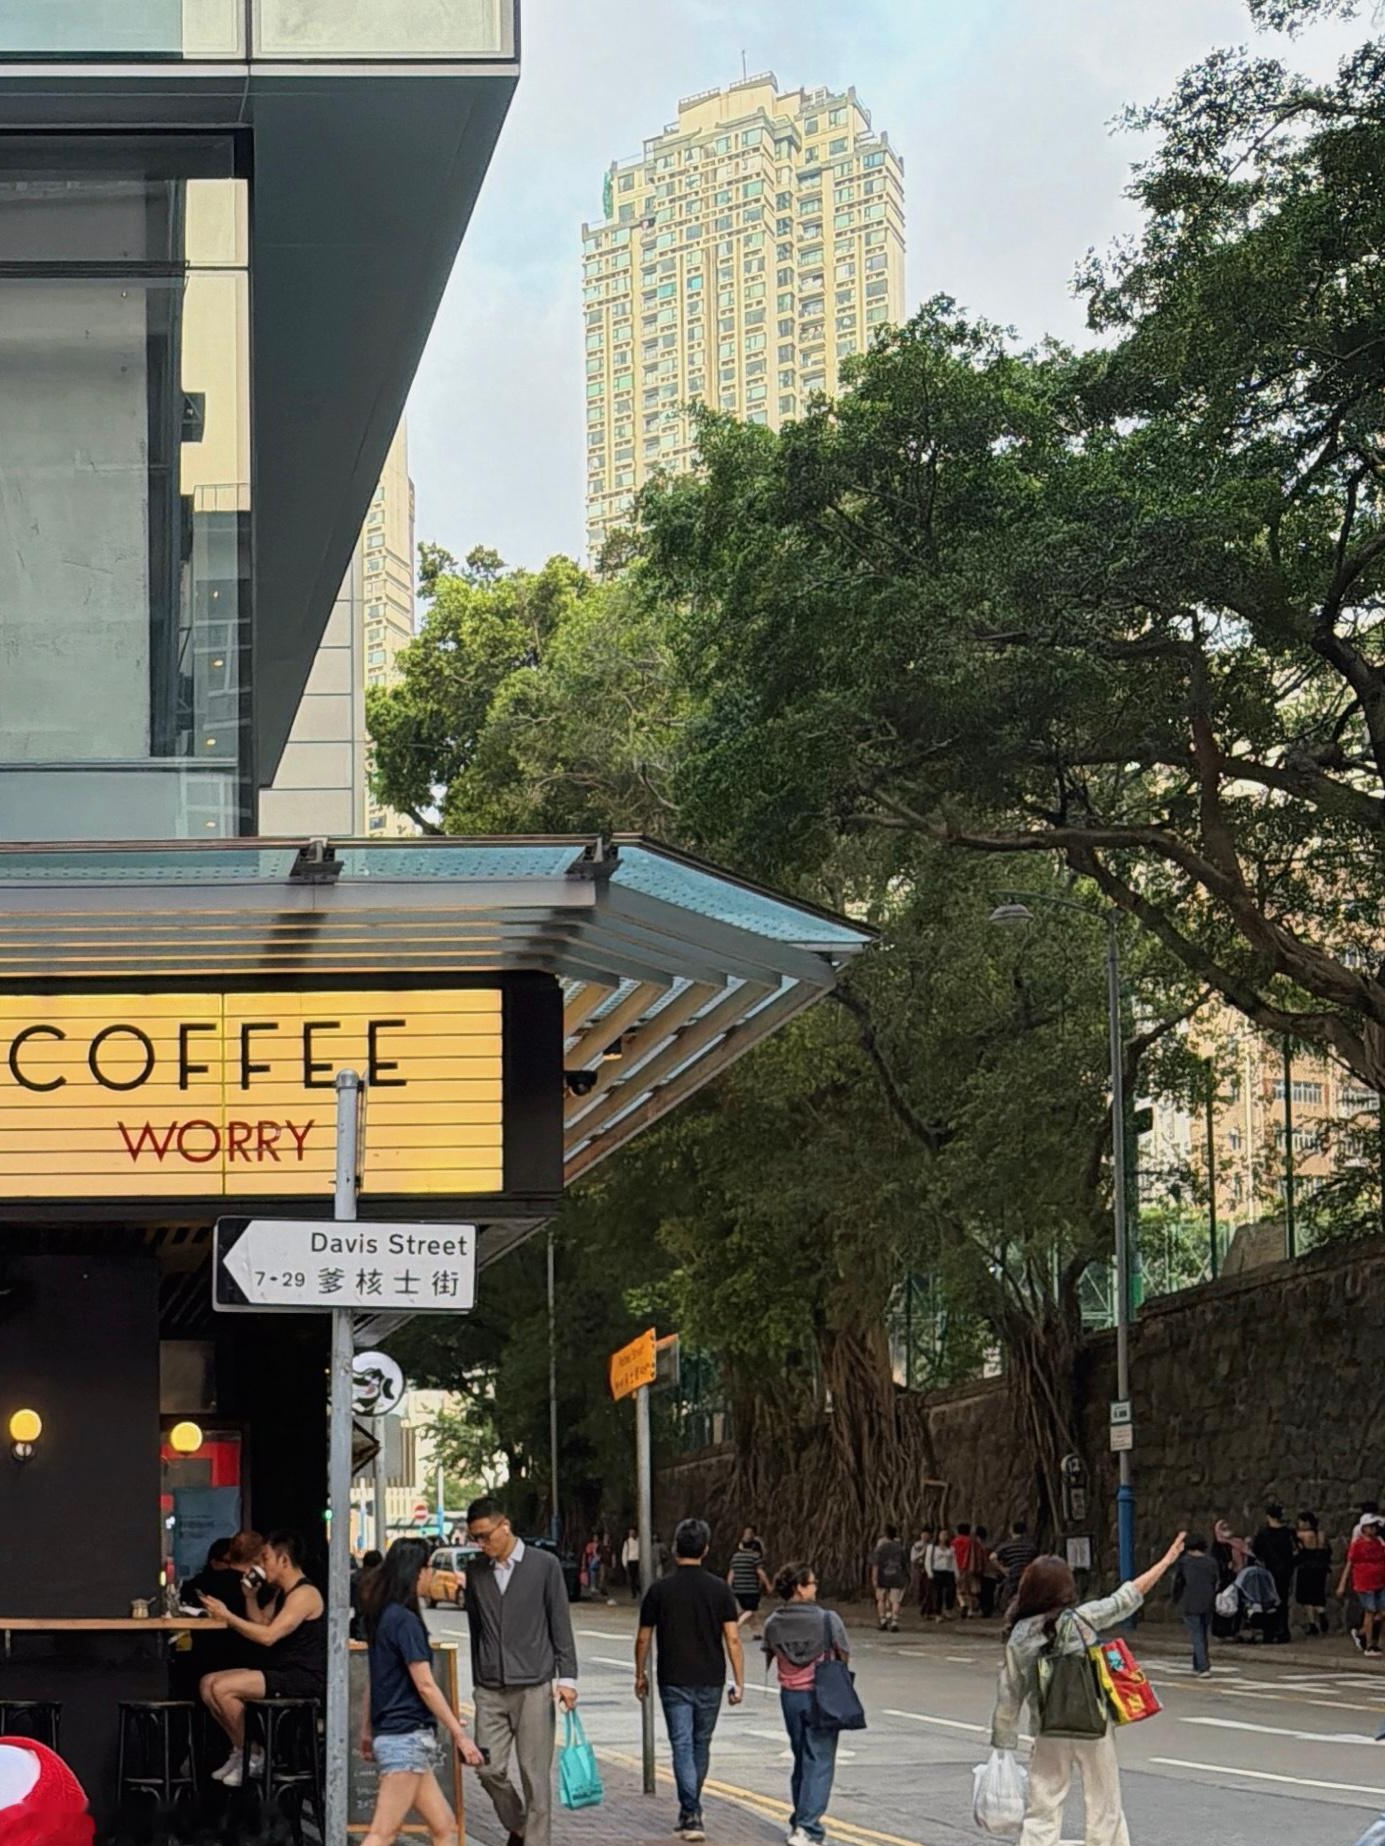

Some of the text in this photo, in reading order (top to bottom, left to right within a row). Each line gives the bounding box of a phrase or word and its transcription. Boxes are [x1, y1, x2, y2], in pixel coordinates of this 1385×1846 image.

[9, 1019, 407, 1092] COFFEE
[117, 1119, 316, 1163] WORRY
[311, 1232, 468, 1256] Davis Street
[255, 1267, 459, 1297] 7-29 爹核士街
